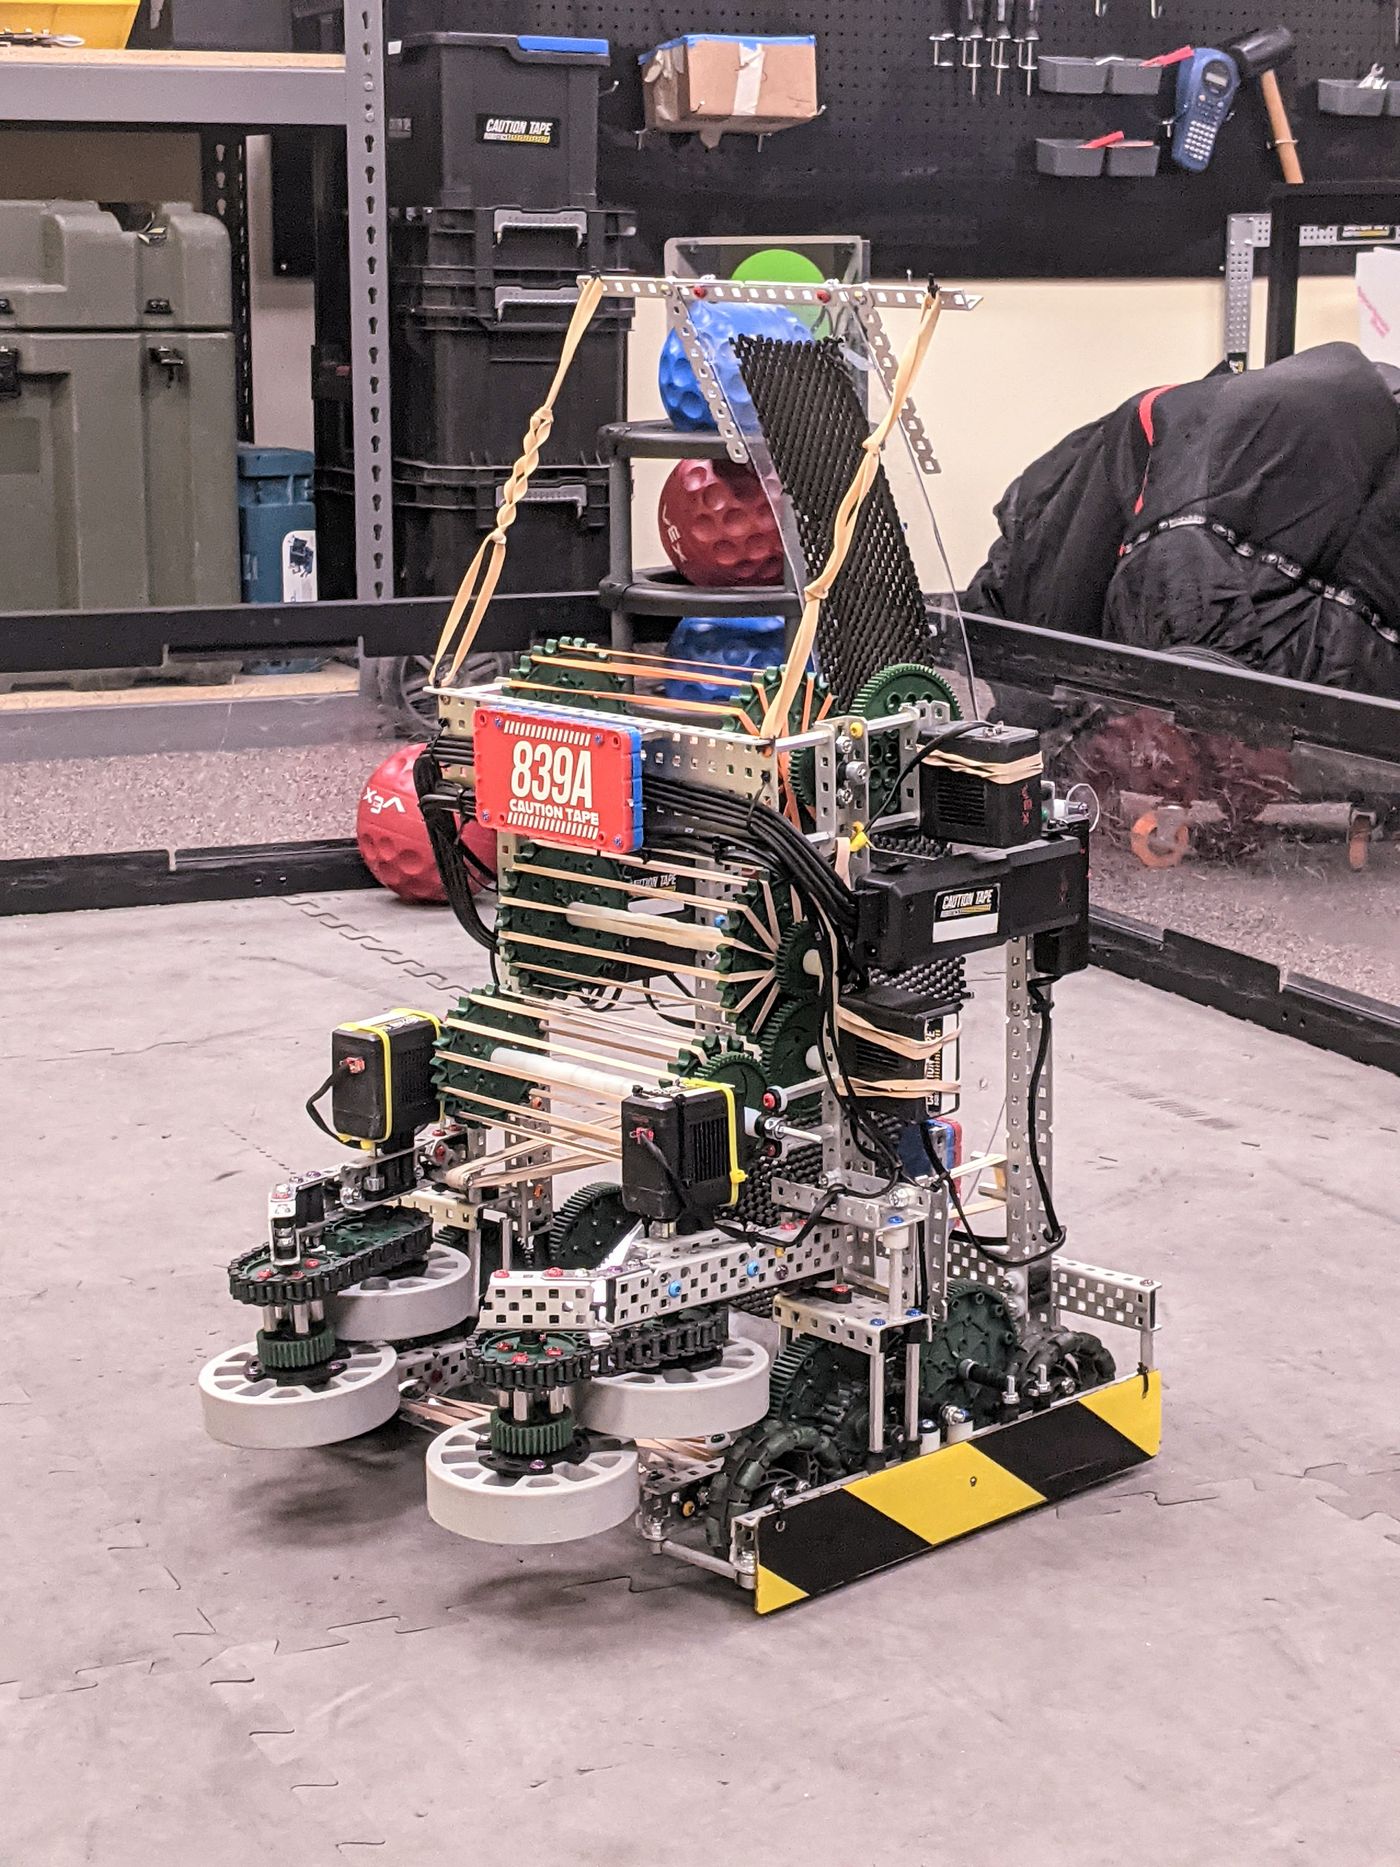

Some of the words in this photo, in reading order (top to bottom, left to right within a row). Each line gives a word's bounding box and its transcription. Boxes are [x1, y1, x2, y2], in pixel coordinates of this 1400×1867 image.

[486, 118, 527, 134] CAUTION
[529, 121, 553, 136] TAPE
[511, 740, 592, 809] 839A
[363, 787, 406, 814] VEX
[509, 798, 563, 819] CAUTION
[566, 808, 599, 826] TAPE
[942, 892, 974, 910] CAUTION
[975, 889, 994, 905] TAPE
